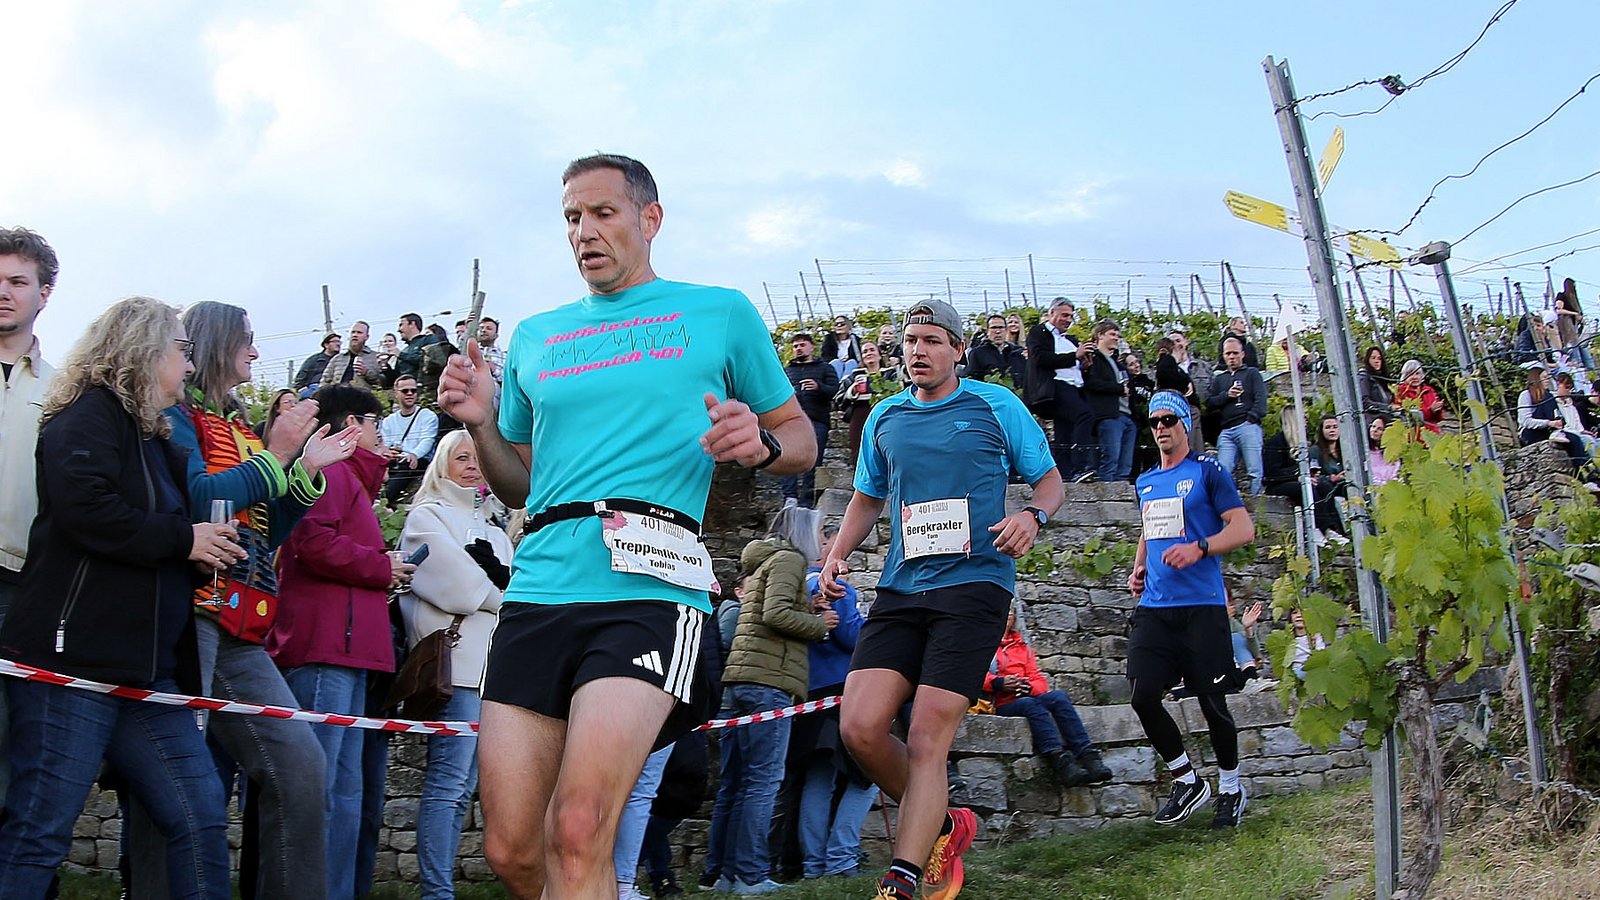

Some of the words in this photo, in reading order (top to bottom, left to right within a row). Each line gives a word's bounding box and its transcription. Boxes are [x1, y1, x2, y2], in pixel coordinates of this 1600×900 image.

[649, 347, 685, 360] 401
[918, 504, 931, 515] 401
[640, 516, 661, 532] 401
[906, 520, 963, 536] Bergkraxler
[613, 538, 681, 561] Treppenlift
[682, 554, 703, 568] 401
[649, 559, 676, 571] Tobias
